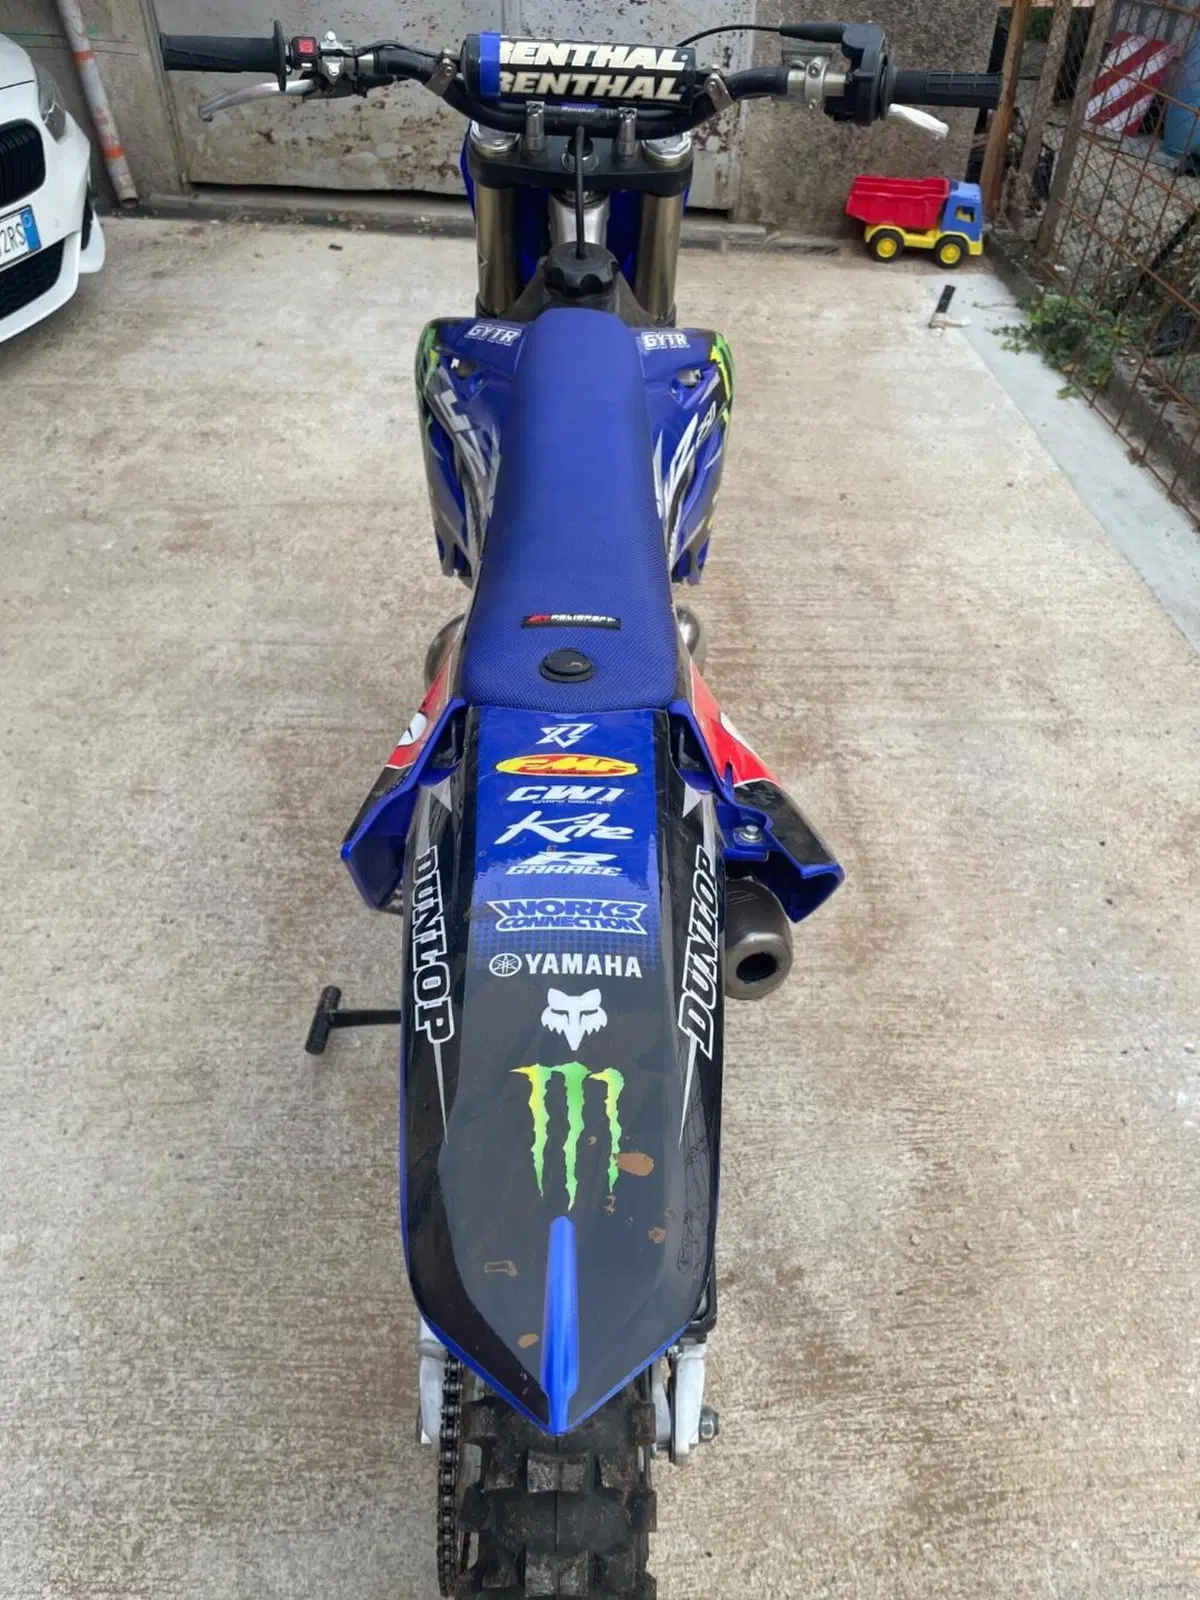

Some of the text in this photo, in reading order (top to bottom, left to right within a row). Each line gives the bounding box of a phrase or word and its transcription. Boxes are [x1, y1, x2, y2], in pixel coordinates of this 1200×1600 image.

[0, 222, 26, 257] 2RS
[464, 323, 522, 346] GYTR
[641, 331, 690, 350] GYTR
[497, 756, 637, 773] FMF
[493, 810, 635, 845] Kite
[505, 864, 623, 877] GARAGE
[499, 900, 642, 918] WORKS
[498, 916, 645, 932] CONNECTION
[413, 845, 455, 1044] DUNLOP
[678, 844, 719, 1061] DUNLOP
[524, 952, 643, 979] YAMAHA
